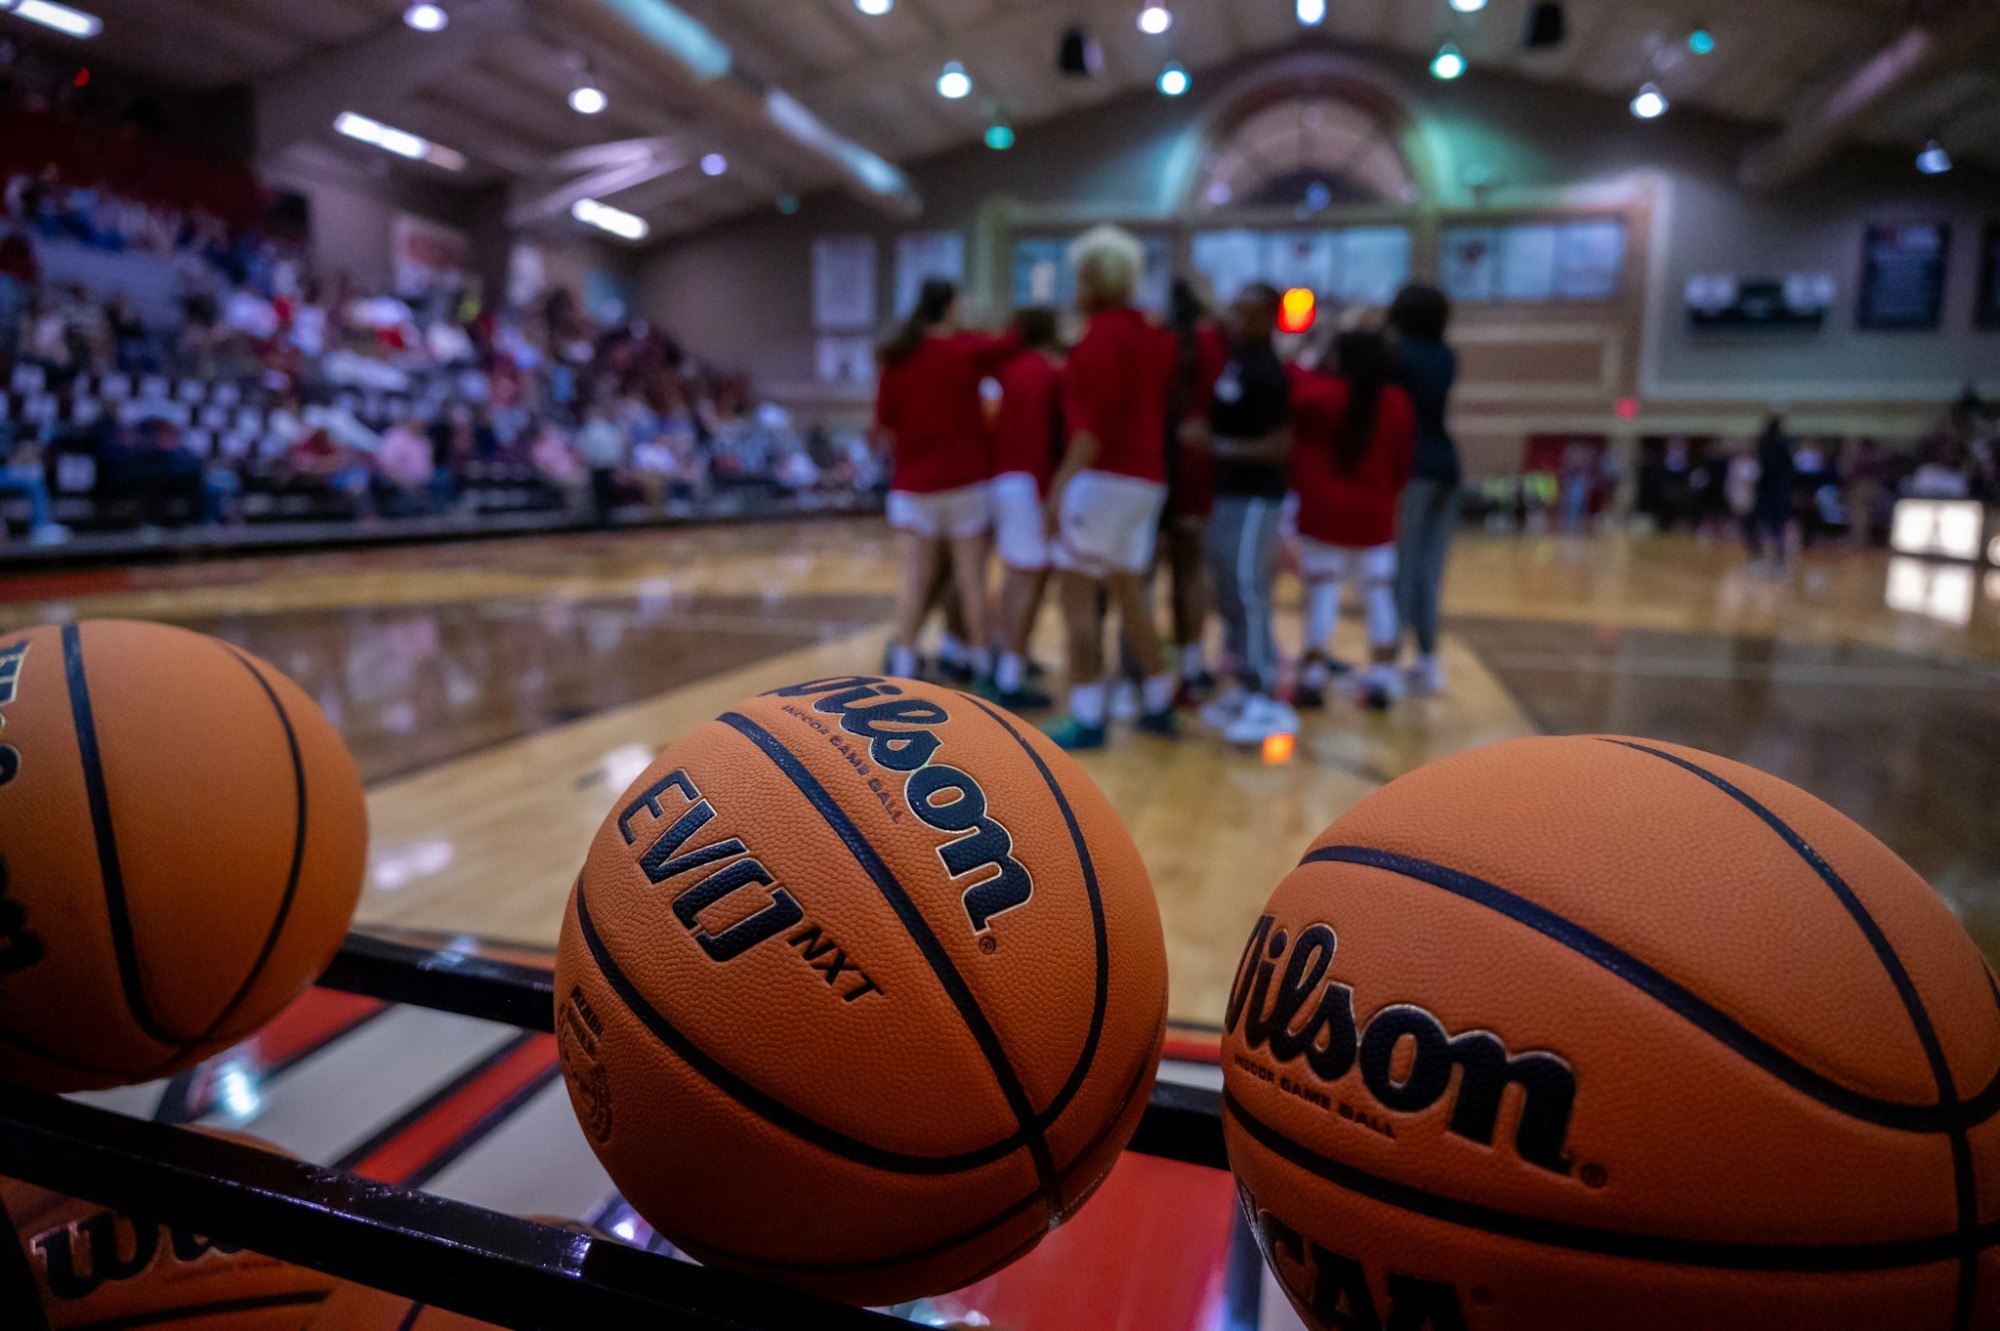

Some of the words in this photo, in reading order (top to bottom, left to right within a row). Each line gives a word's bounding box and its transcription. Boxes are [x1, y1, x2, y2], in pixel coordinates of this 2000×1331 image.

[782, 704, 830, 736] INDOOR
[829, 735, 870, 777] GAME
[867, 778, 903, 824] BALL
[616, 768, 804, 963] EVO
[788, 924, 886, 1003] NXT
[1280, 1076, 1332, 1112] GAME
[1338, 1102, 1399, 1140] BALL
